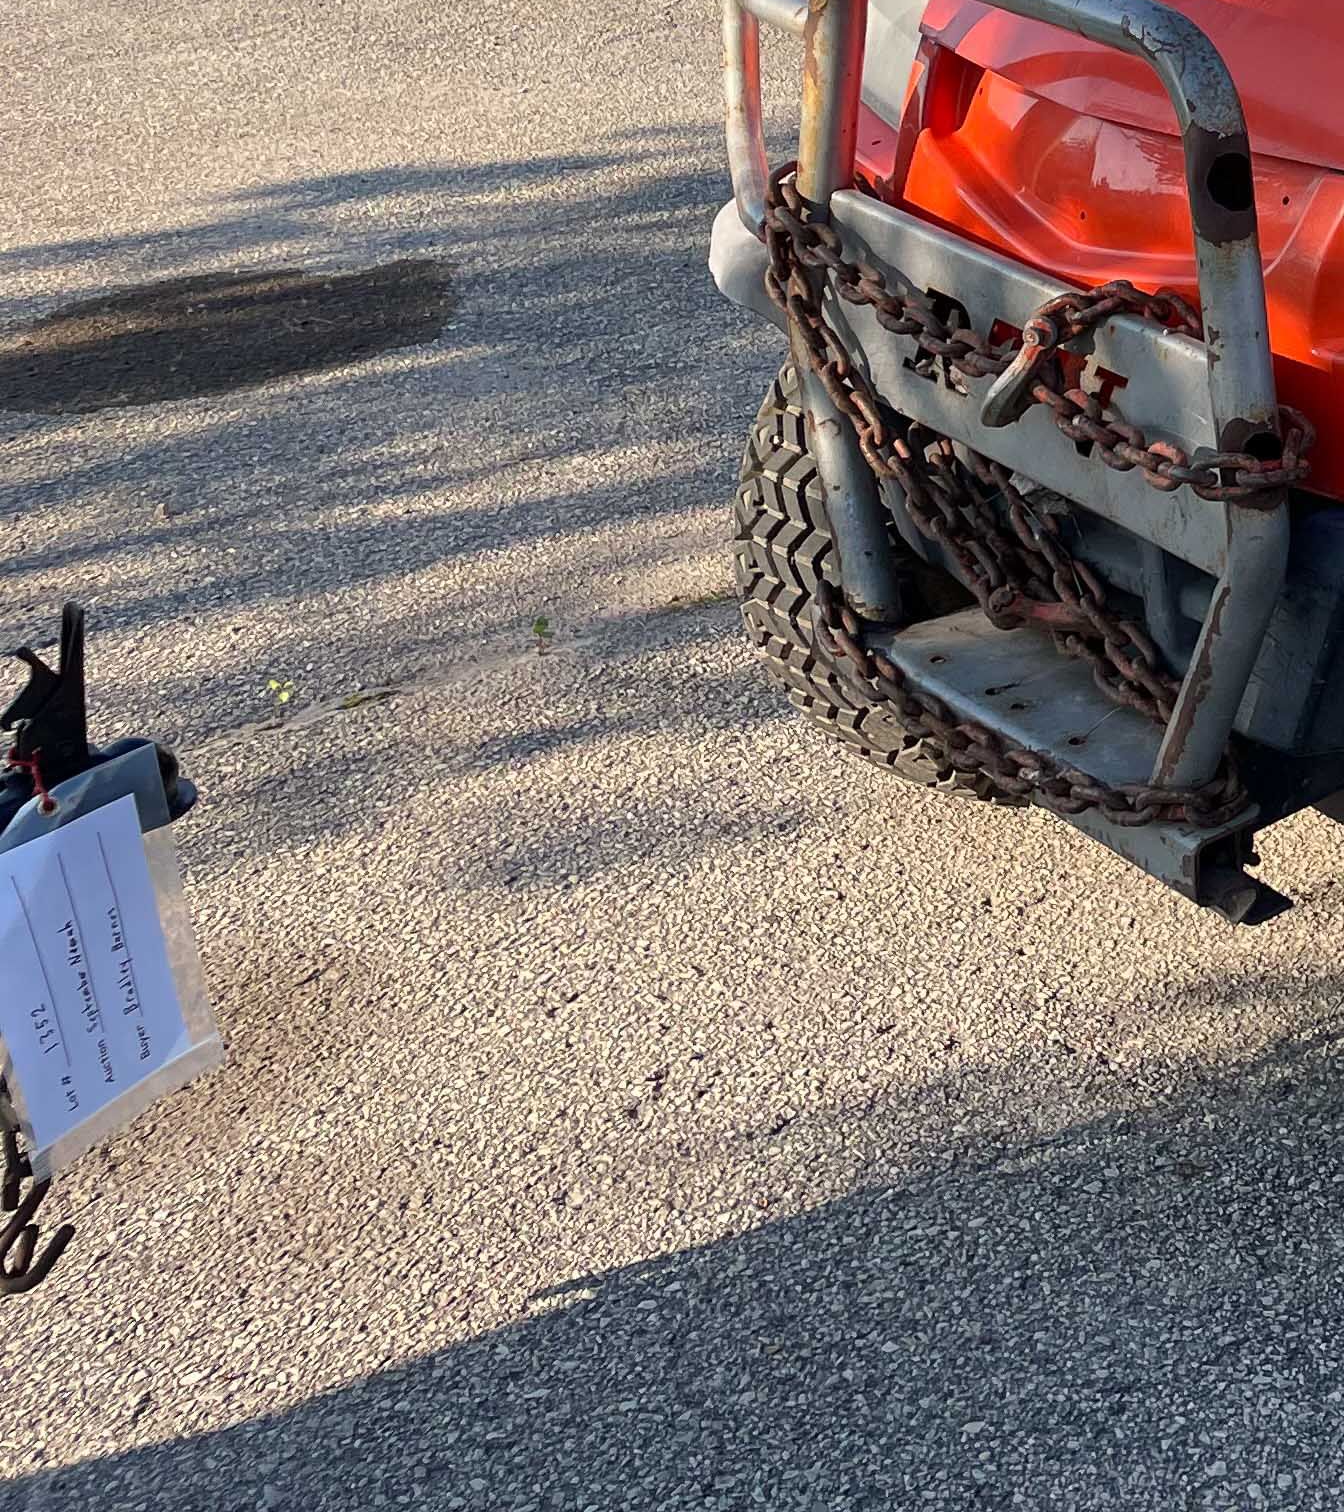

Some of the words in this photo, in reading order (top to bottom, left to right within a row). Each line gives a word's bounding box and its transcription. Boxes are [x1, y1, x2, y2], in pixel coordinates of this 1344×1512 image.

[117, 957, 140, 1016] Bradley
[31, 1003, 60, 1055] 1352
[136, 1024, 152, 1061] Buyer
[97, 1039, 116, 1083] Auction
[67, 1089, 80, 1113] Lot
